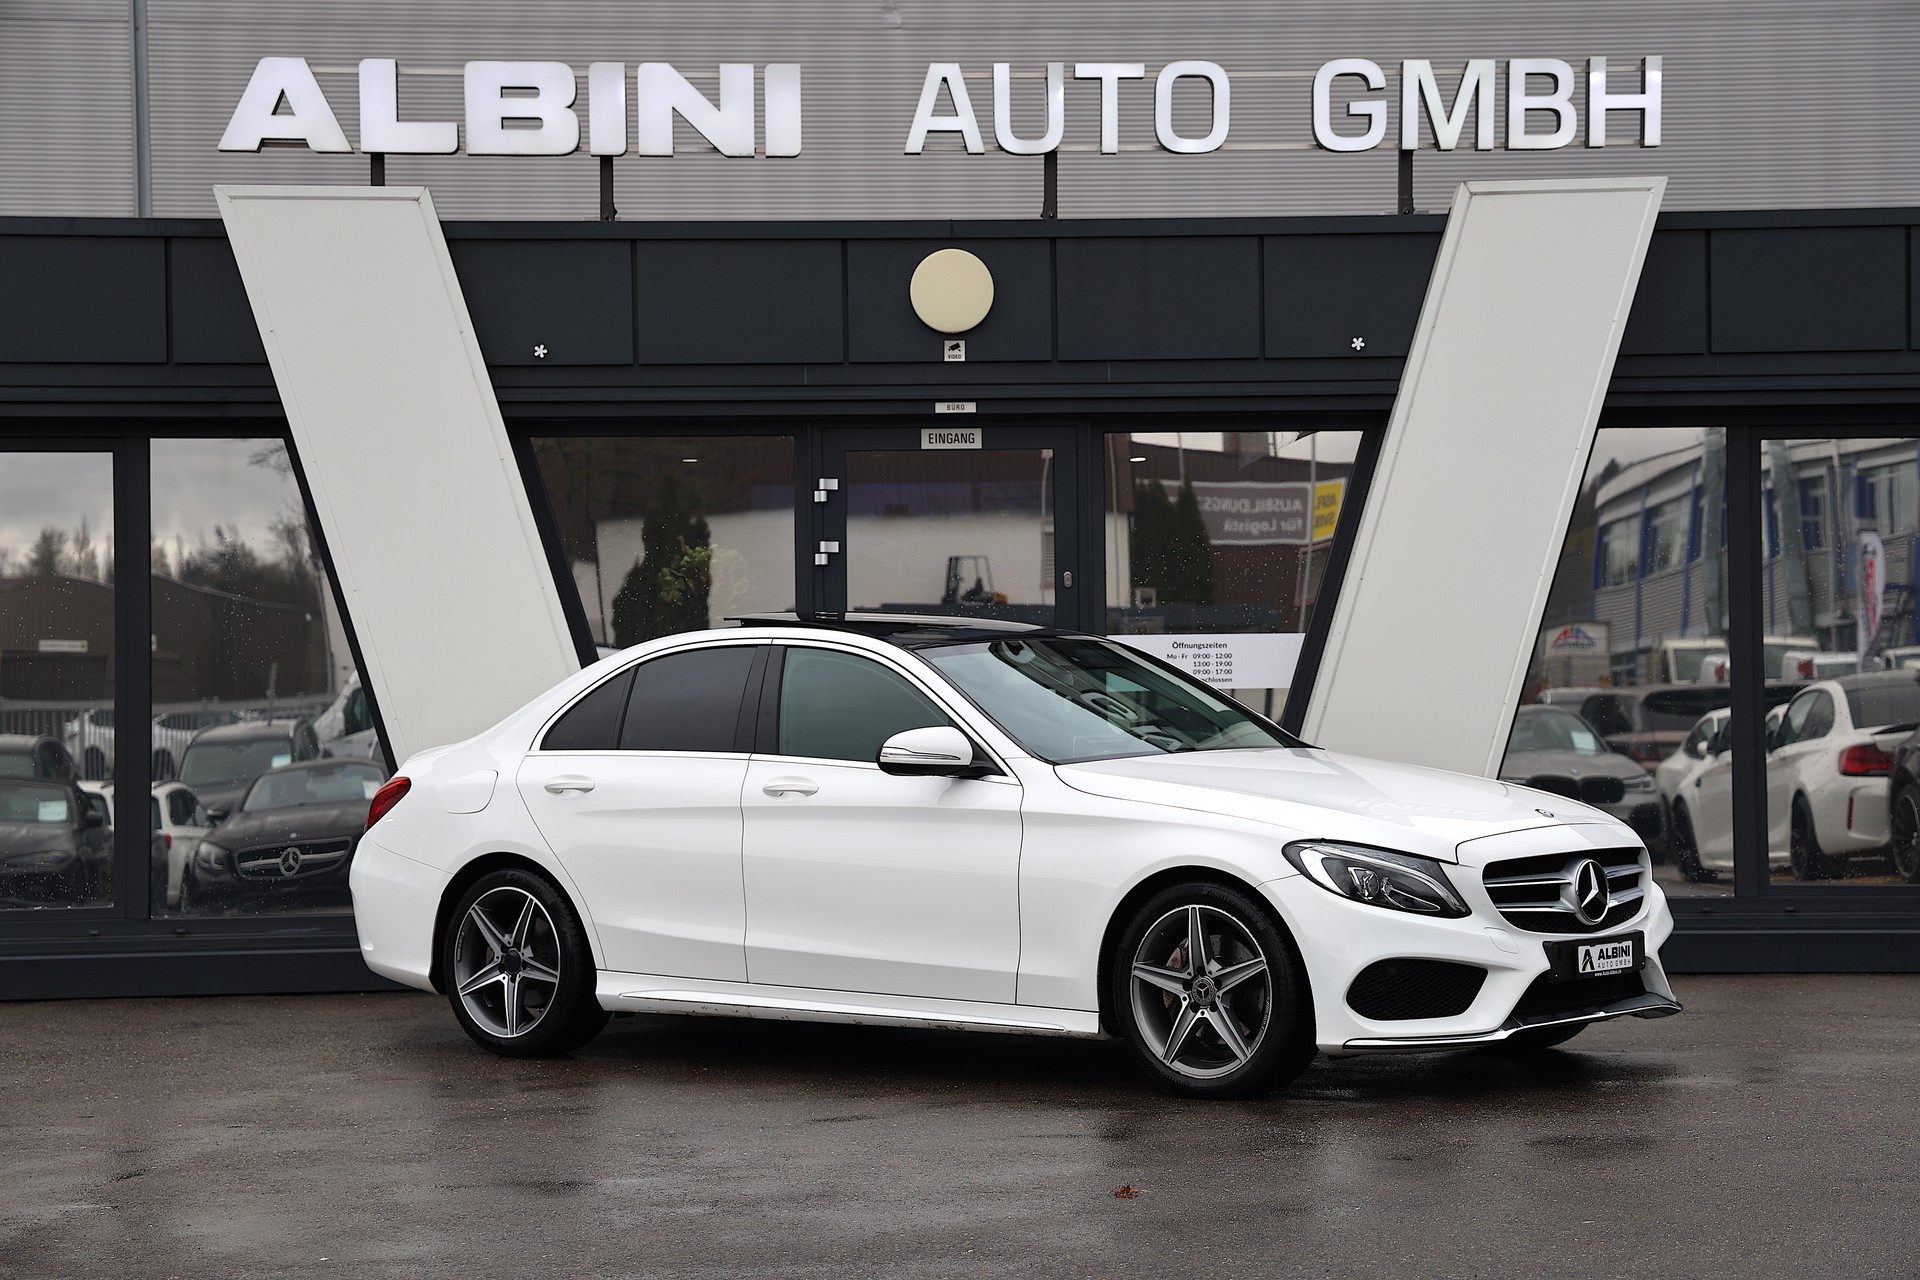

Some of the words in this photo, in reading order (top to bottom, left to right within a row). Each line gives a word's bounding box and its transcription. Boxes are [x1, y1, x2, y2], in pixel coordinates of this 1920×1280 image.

[217, 57, 802, 158] ALBINI
[904, 59, 1231, 156] AUTO
[1311, 54, 1663, 153] GMBH
[947, 403, 965, 411] BÜRO
[928, 432, 976, 444] EINGANG
[1172, 641, 1228, 650] Öffnungszeiten
[1597, 945, 1630, 960] ALBINI
[1598, 961, 1613, 969] AUTO
[1615, 958, 1631, 967] GMBH
